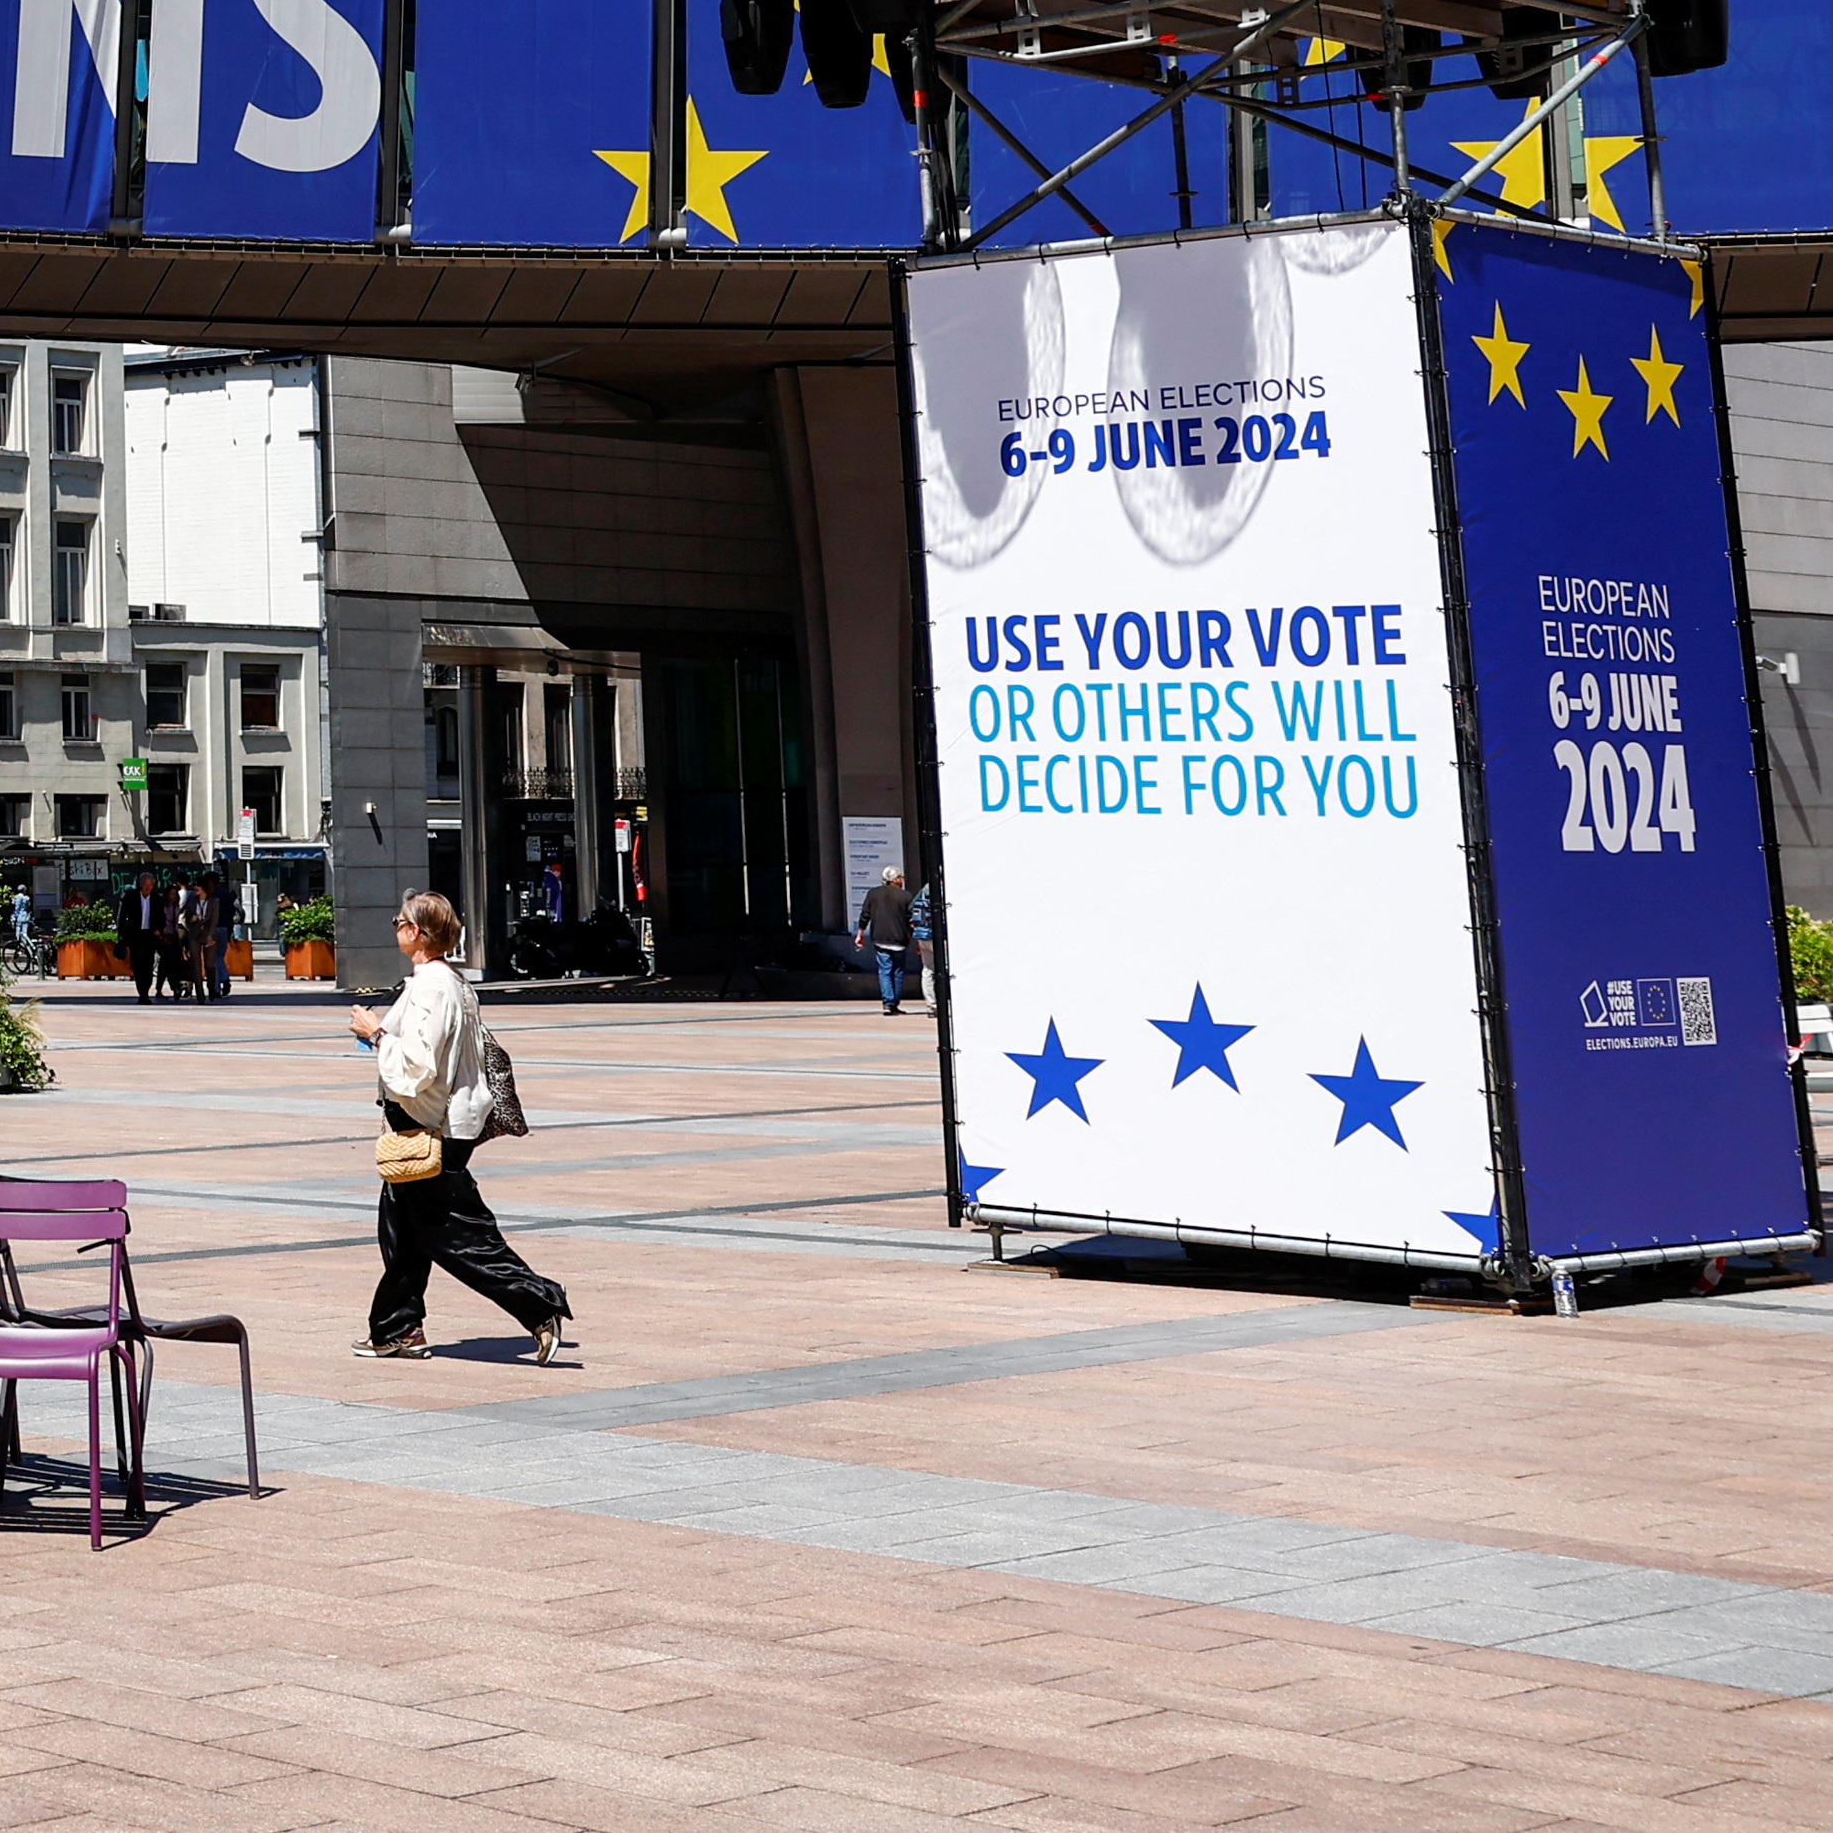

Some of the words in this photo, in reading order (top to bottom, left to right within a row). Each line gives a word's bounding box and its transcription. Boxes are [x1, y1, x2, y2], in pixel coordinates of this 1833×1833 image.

[998, 389, 1149, 422] EUROPEAN
[1160, 376, 1325, 410] ELECTIONS
[1000, 427, 1075, 477] 6-9
[1088, 418, 1206, 472] JUNE
[1217, 411, 1332, 463] 2024
[1538, 575, 1670, 619] EUROPEAN
[966, 614, 1064, 673] USE
[1075, 610, 1234, 670] YOUR
[1246, 604, 1407, 667] VOTE
[1542, 620, 1675, 663] ELECTIONS
[969, 684, 1036, 743] OR
[1052, 680, 1254, 743] OTHERS
[1271, 679, 1417, 742] WILL
[1549, 671, 1601, 730] 6-9
[1608, 672, 1682, 732] JUNE
[979, 754, 1162, 815] DECIDE
[1181, 754, 1287, 817] FOR
[1301, 754, 1419, 819] YOU
[1553, 739, 1696, 854] 2024
[1607, 980, 1633, 995] #USE
[1608, 995, 1635, 1011] YOUR
[1609, 1011, 1637, 1027] VOTE
[1586, 1035, 1678, 1051] ELECTIONS.EUROPA.EU
